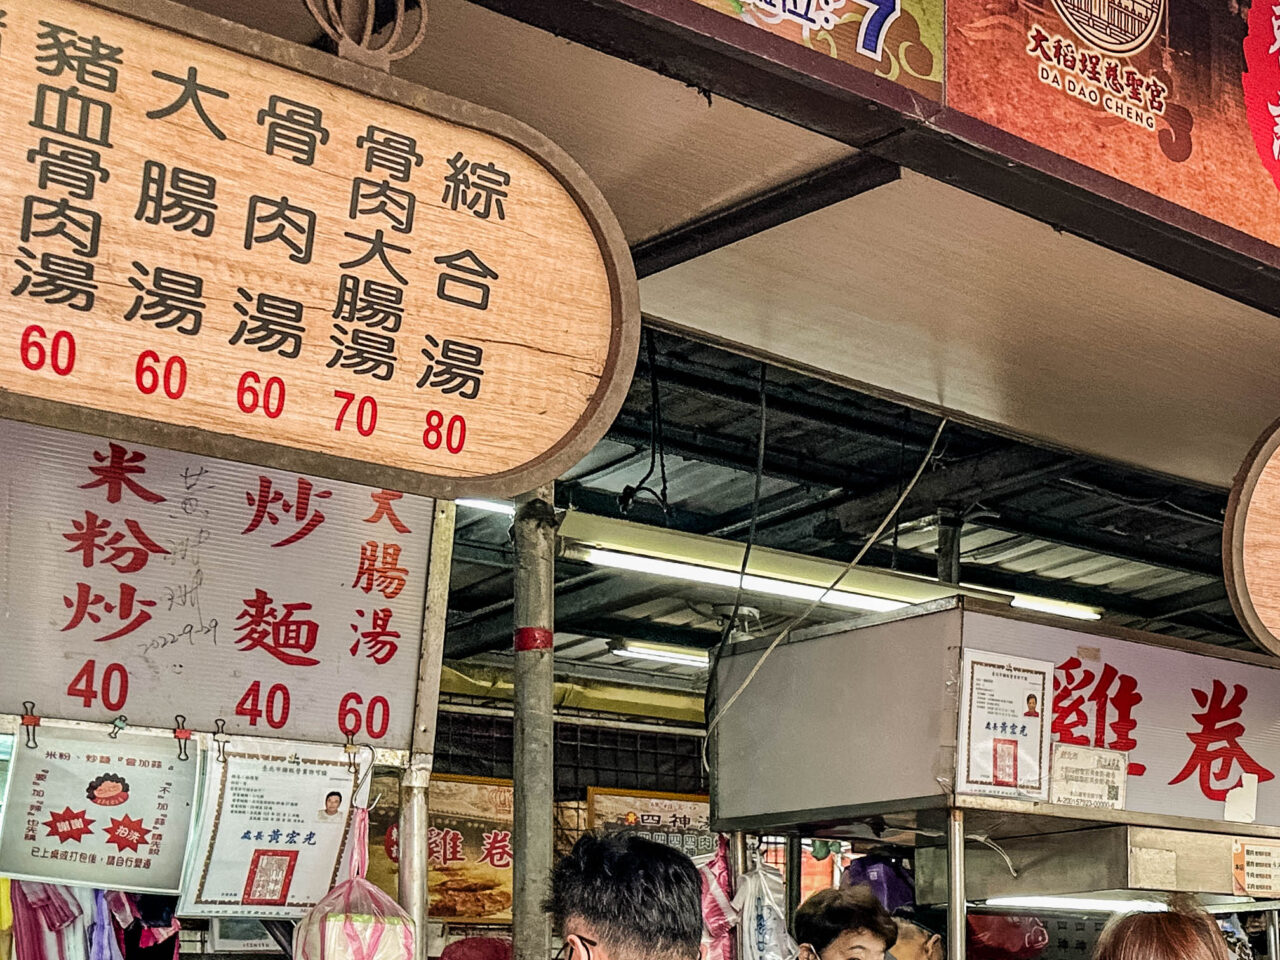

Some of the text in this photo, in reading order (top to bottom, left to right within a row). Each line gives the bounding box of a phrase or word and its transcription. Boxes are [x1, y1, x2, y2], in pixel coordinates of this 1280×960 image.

[1029, 27, 1166, 113] 大稻埕慈聖宮
[1040, 67, 1155, 129] DA DAO CHENG
[11, 20, 124, 312] 豬血骨肉湯
[125, 66, 230, 336] 大腸湯
[229, 94, 330, 359] 骨肉湯
[326, 125, 424, 382] 骨肉大腸湯
[417, 151, 511, 399] 綜合湯
[20, 325, 76, 376] 60
[135, 350, 188, 400] 60
[236, 370, 286, 419] 60
[333, 390, 378, 437] 70
[423, 410, 467, 454] 80
[61, 442, 171, 642] 米粉炒
[234, 476, 333, 667] 炒麵
[349, 489, 413, 664] 大腸湯
[67, 659, 129, 712] 40
[236, 681, 291, 729] 40
[338, 692, 391, 739] 60
[1051, 655, 1276, 801] 雞卷
[428, 827, 513, 868] 雞卷
